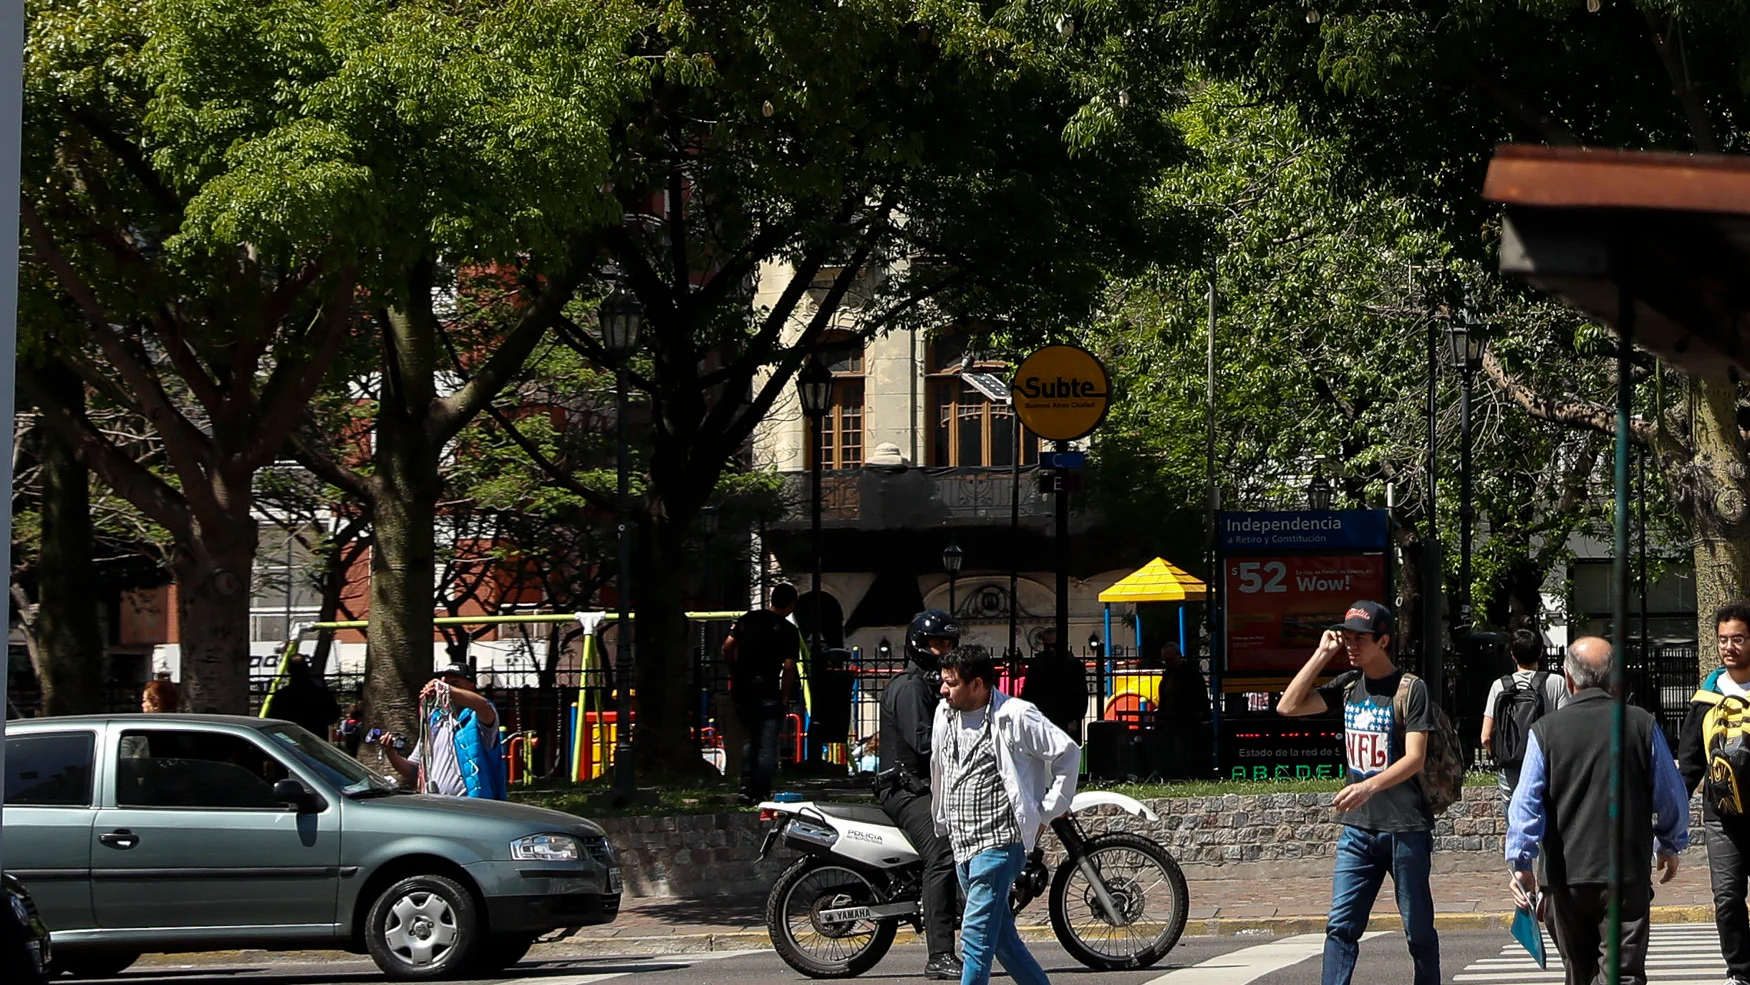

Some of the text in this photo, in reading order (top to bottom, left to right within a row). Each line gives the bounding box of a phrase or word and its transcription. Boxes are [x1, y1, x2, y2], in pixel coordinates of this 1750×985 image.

[1025, 375, 1096, 398] Subte
[1053, 453, 1063, 468] C
[1053, 476, 1063, 491] E
[1227, 516, 1342, 534] Independencia
[1236, 535, 1263, 544] Retiro
[1271, 533, 1327, 544] Constitución
[1296, 575, 1350, 593] Wow!
[1238, 748, 1273, 758] Estado
[1275, 748, 1288, 757] de
[1290, 748, 1299, 757] la
[1301, 747, 1318, 757] red
[1320, 747, 1333, 757] de
[1345, 731, 1387, 772] NFL
[847, 829, 883, 842] POLICIA
[837, 909, 871, 920] YAMAHA
